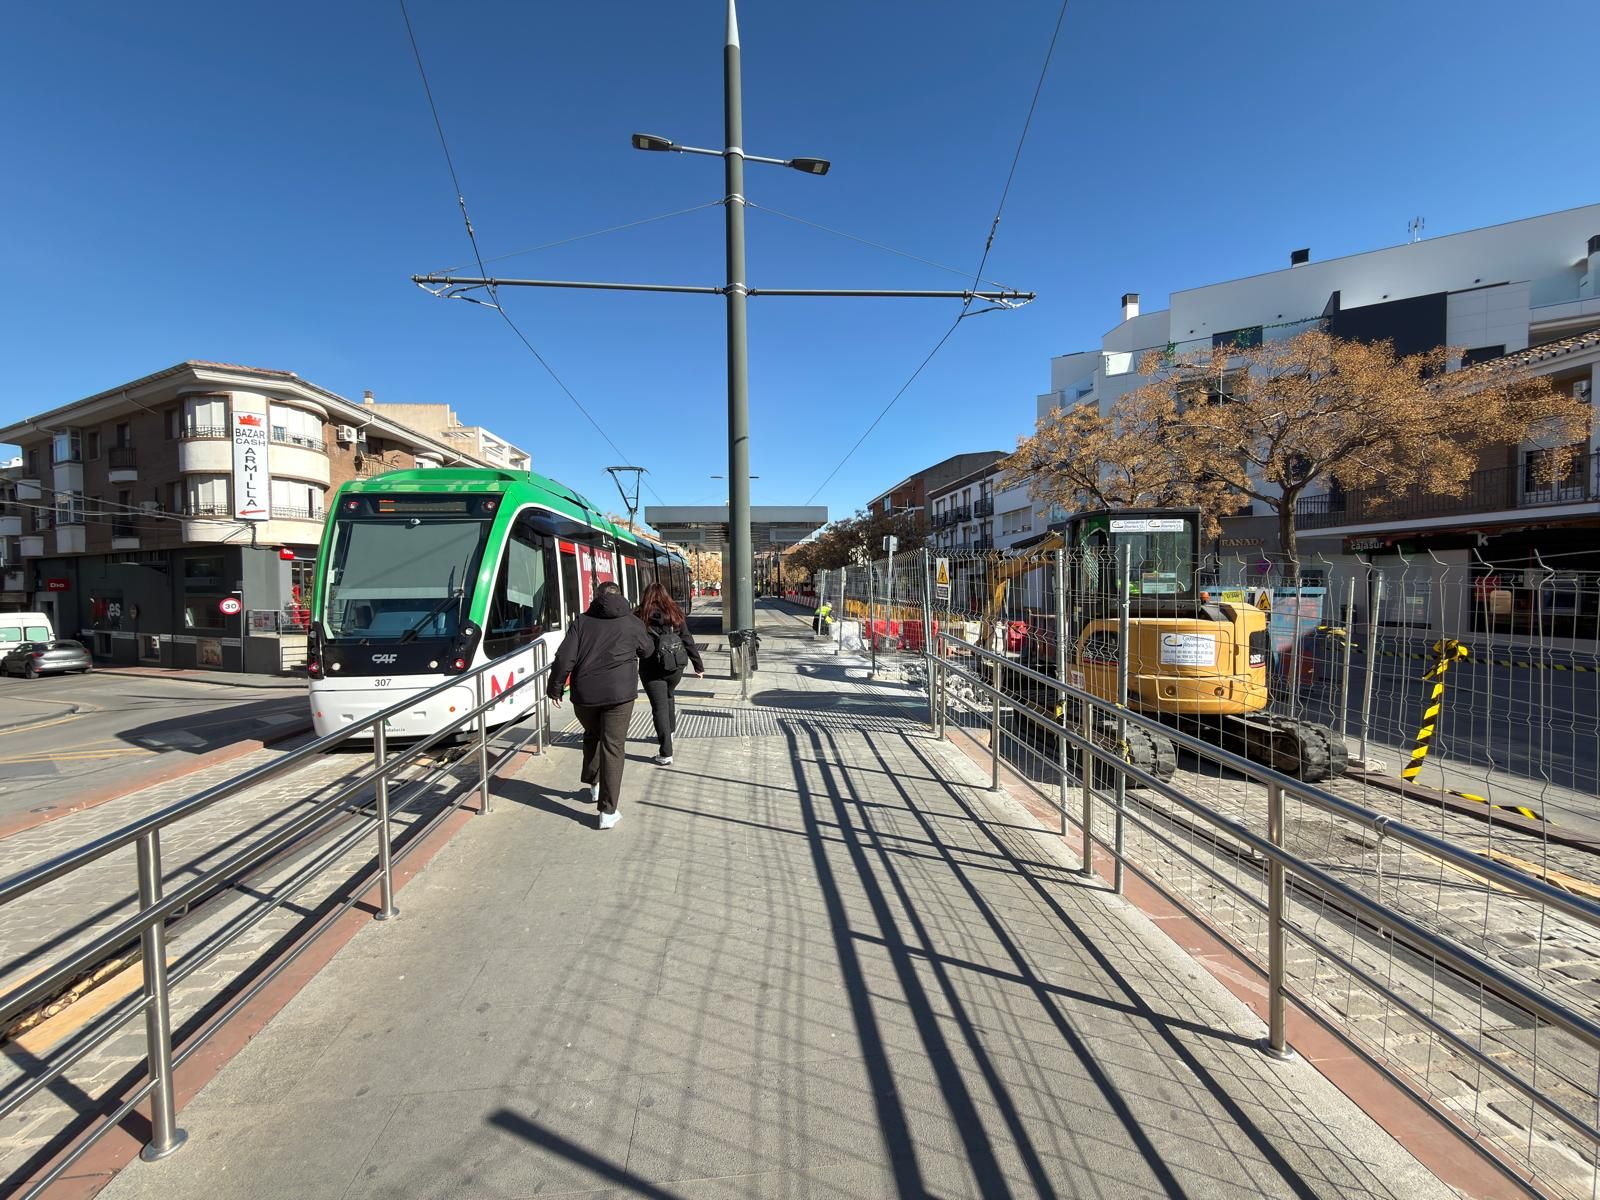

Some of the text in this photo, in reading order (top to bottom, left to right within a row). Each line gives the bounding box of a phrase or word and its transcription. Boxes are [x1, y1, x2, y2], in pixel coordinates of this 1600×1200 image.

[235, 428, 266, 439] BAZAR
[235, 438, 266, 447] CASH
[244, 447, 258, 507] ARMILLA
[374, 678, 392, 687] 307
